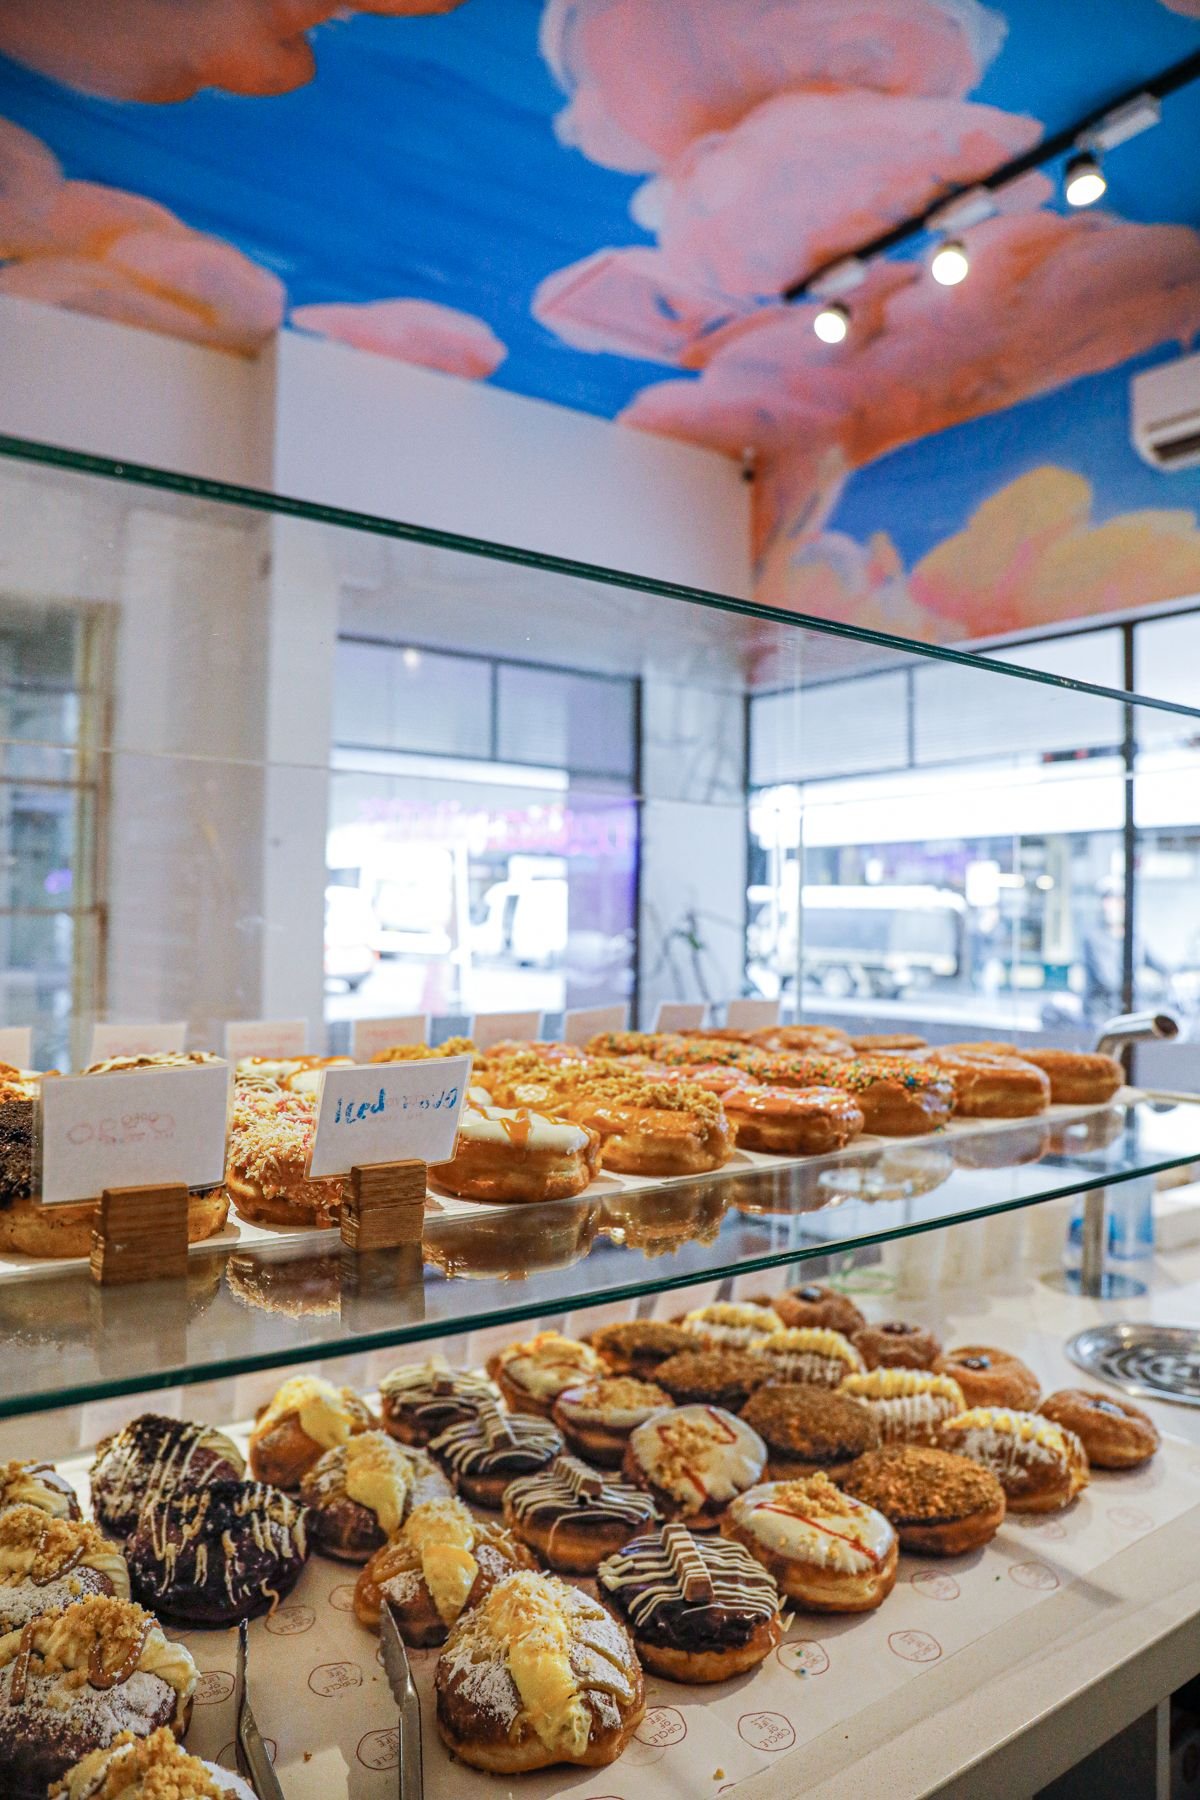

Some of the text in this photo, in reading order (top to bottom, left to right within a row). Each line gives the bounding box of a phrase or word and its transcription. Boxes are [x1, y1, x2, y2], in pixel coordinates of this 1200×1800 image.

[322, 1678, 358, 1693] CIRCLE
[192, 1686, 229, 1701] CIRCLE
[646, 1711, 667, 1724] LIFE
[649, 1723, 682, 1743] CIRCLE
[759, 1728, 790, 1747] CIRCLE
